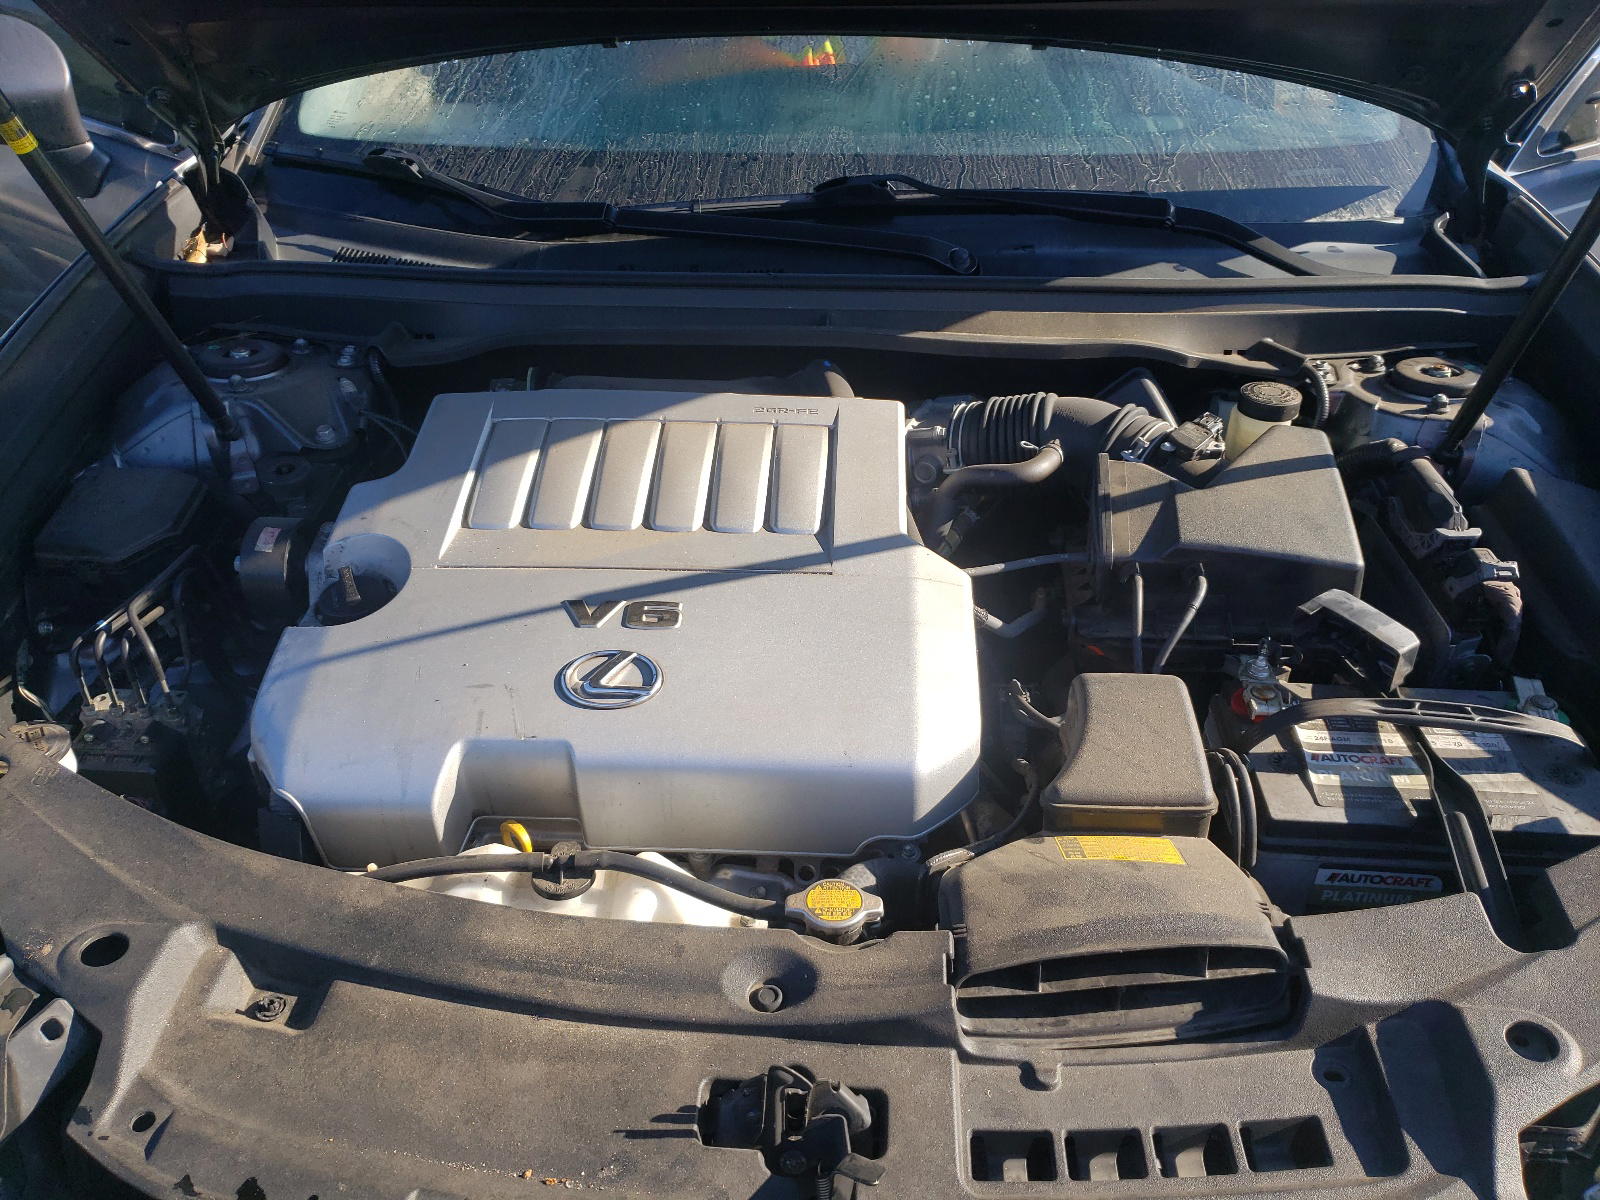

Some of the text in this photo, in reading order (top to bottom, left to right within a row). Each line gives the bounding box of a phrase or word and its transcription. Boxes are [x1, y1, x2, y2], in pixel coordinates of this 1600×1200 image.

[560, 599, 683, 630] V6
[1320, 752, 1405, 766] AUTOCRAFT
[1336, 872, 1434, 888] AUTOCRAFT
